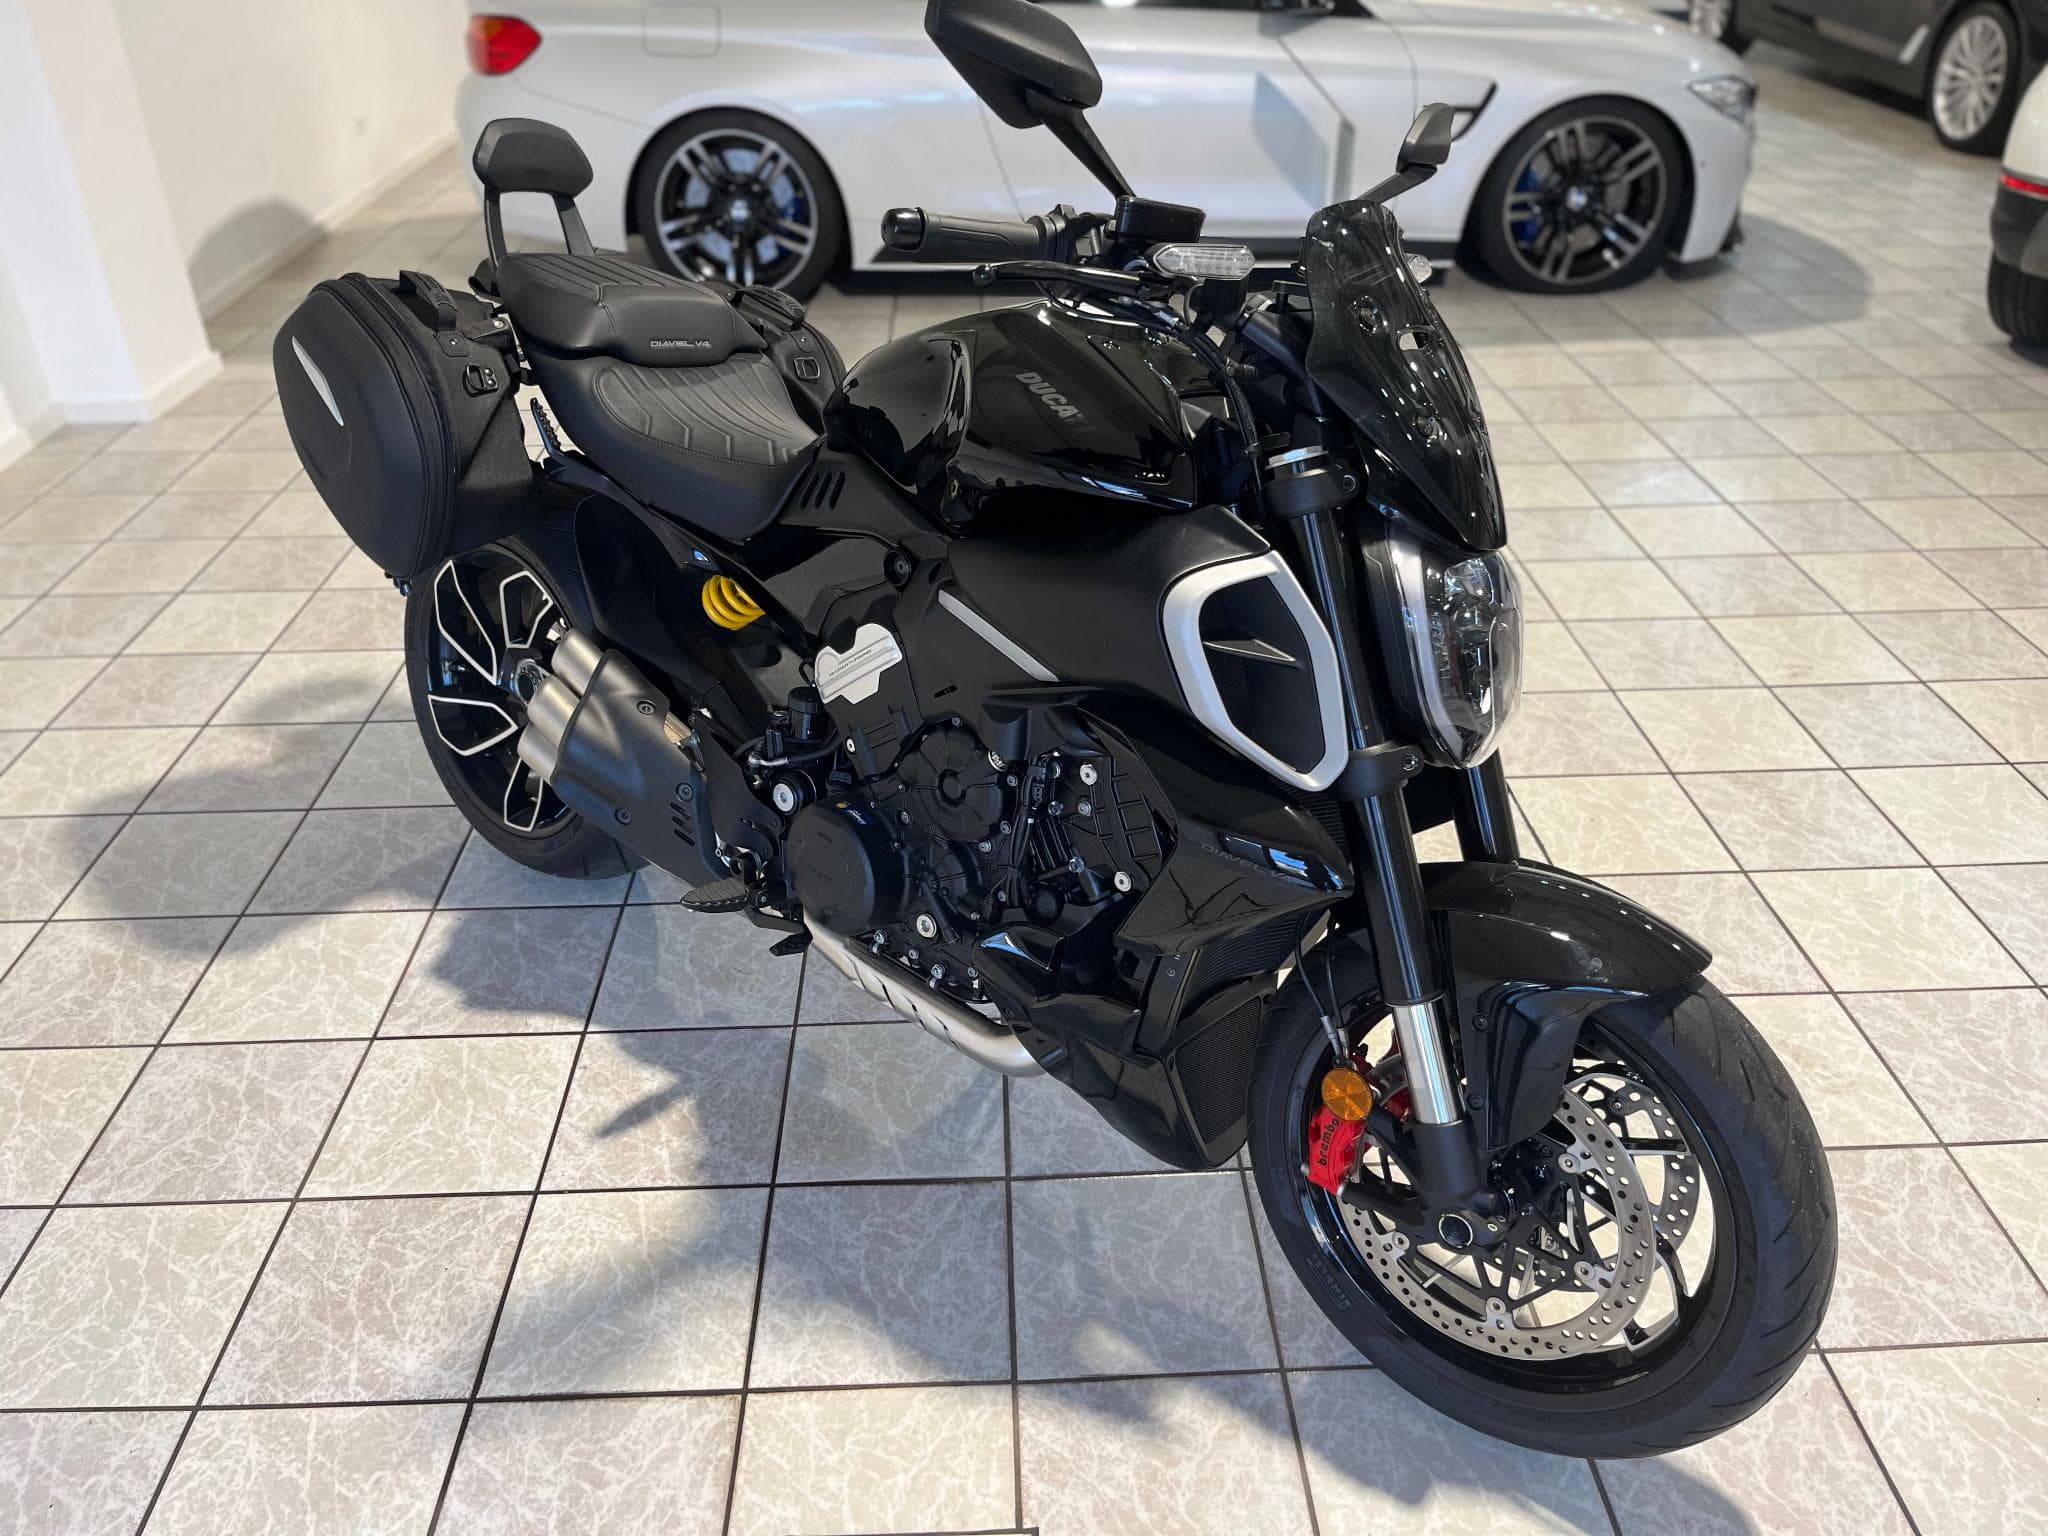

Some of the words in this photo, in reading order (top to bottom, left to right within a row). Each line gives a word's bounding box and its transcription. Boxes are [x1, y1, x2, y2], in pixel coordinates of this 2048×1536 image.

[650, 340, 694, 348] DIAVEL
[695, 340, 712, 349] V4
[1200, 842, 1266, 875] DIAVEL
[1317, 1117, 1340, 1166] brembo
